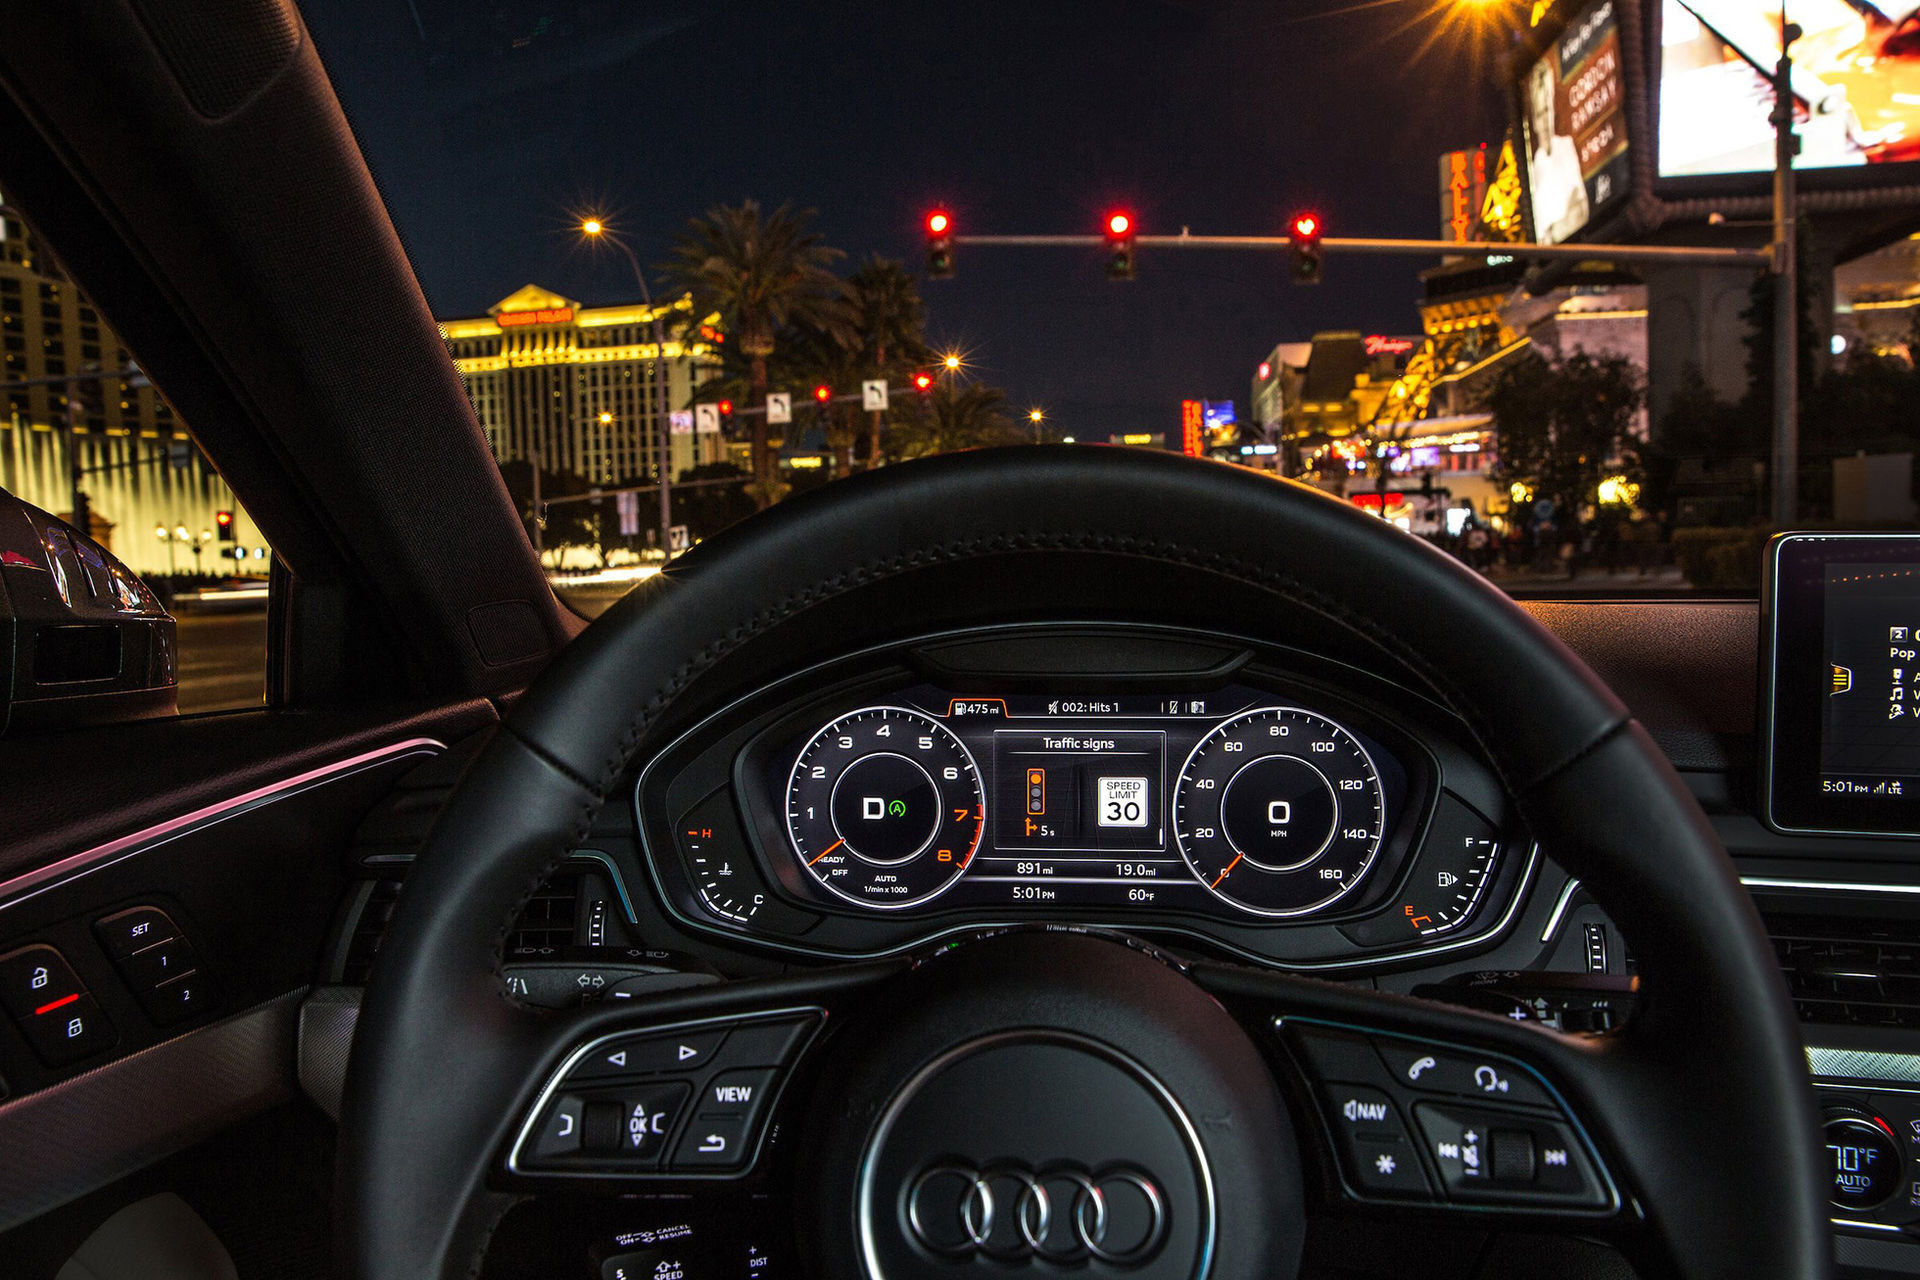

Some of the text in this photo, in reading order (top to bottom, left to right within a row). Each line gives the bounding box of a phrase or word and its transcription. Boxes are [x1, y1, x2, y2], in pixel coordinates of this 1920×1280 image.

[1890, 647, 1916, 661] Pop
[1062, 702, 1119, 712] 002: Hits 1
[876, 725, 890, 737] 4
[1270, 726, 1289, 736] 80
[838, 737, 853, 749] 3
[918, 737, 933, 749] 5
[1043, 737, 1115, 751] Traffic signs
[1224, 742, 1243, 752] 60
[1311, 742, 1335, 752] 100
[812, 766, 826, 779] 2
[944, 767, 958, 779] 6
[1107, 782, 1140, 790] SPEED
[1196, 779, 1215, 789] 40
[1339, 780, 1363, 790] 120
[807, 807, 814, 819] 1
[863, 798, 885, 820] D
[1107, 802, 1140, 821] 30
[1268, 801, 1290, 824] 0
[954, 810, 968, 821] 7
[702, 828, 711, 838] H
[1195, 828, 1214, 838] 20
[1343, 829, 1367, 839] 140
[1465, 838, 1473, 847] F
[937, 850, 952, 861] 8
[1319, 869, 1343, 879] 160
[754, 895, 764, 904] C
[1405, 906, 1413, 916] E
[132, 922, 149, 937] SET
[161, 957, 167, 966] 1
[184, 990, 190, 1000] 2
[716, 1087, 752, 1102] VIEW
[1358, 1103, 1386, 1121] NAV
[629, 1118, 648, 1133] OK
[1836, 1174, 1871, 1187] AUTO
[616, 1224, 690, 1241] OFF CANCEL
[659, 1229, 692, 1240] RESUME
[750, 1257, 768, 1267] DIST
[654, 1271, 683, 1280] SPEED
